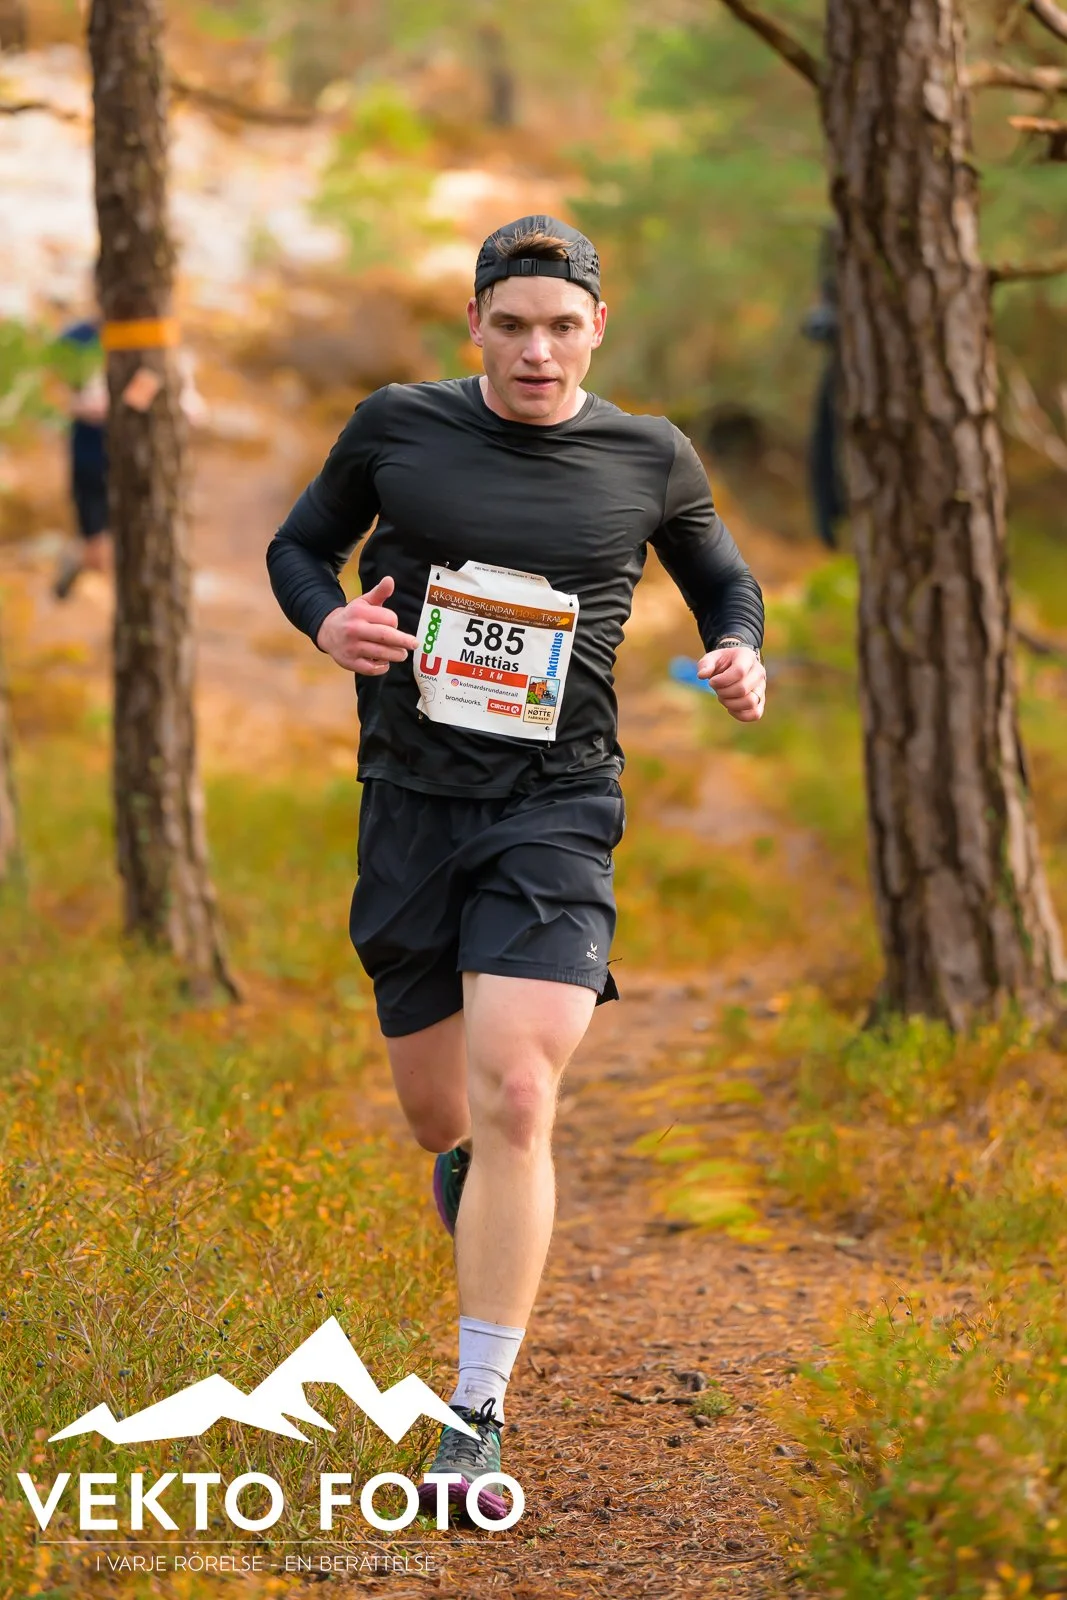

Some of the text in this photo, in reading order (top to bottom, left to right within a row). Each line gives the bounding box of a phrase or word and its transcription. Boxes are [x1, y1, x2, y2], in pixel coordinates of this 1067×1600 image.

[423, 608, 442, 654] coop
[463, 618, 526, 655] 585
[459, 648, 519, 672] Mattias
[546, 632, 564, 678] Aktivitus
[489, 702, 520, 714] CIRCLE K
[527, 709, 551, 717] NØTTE
